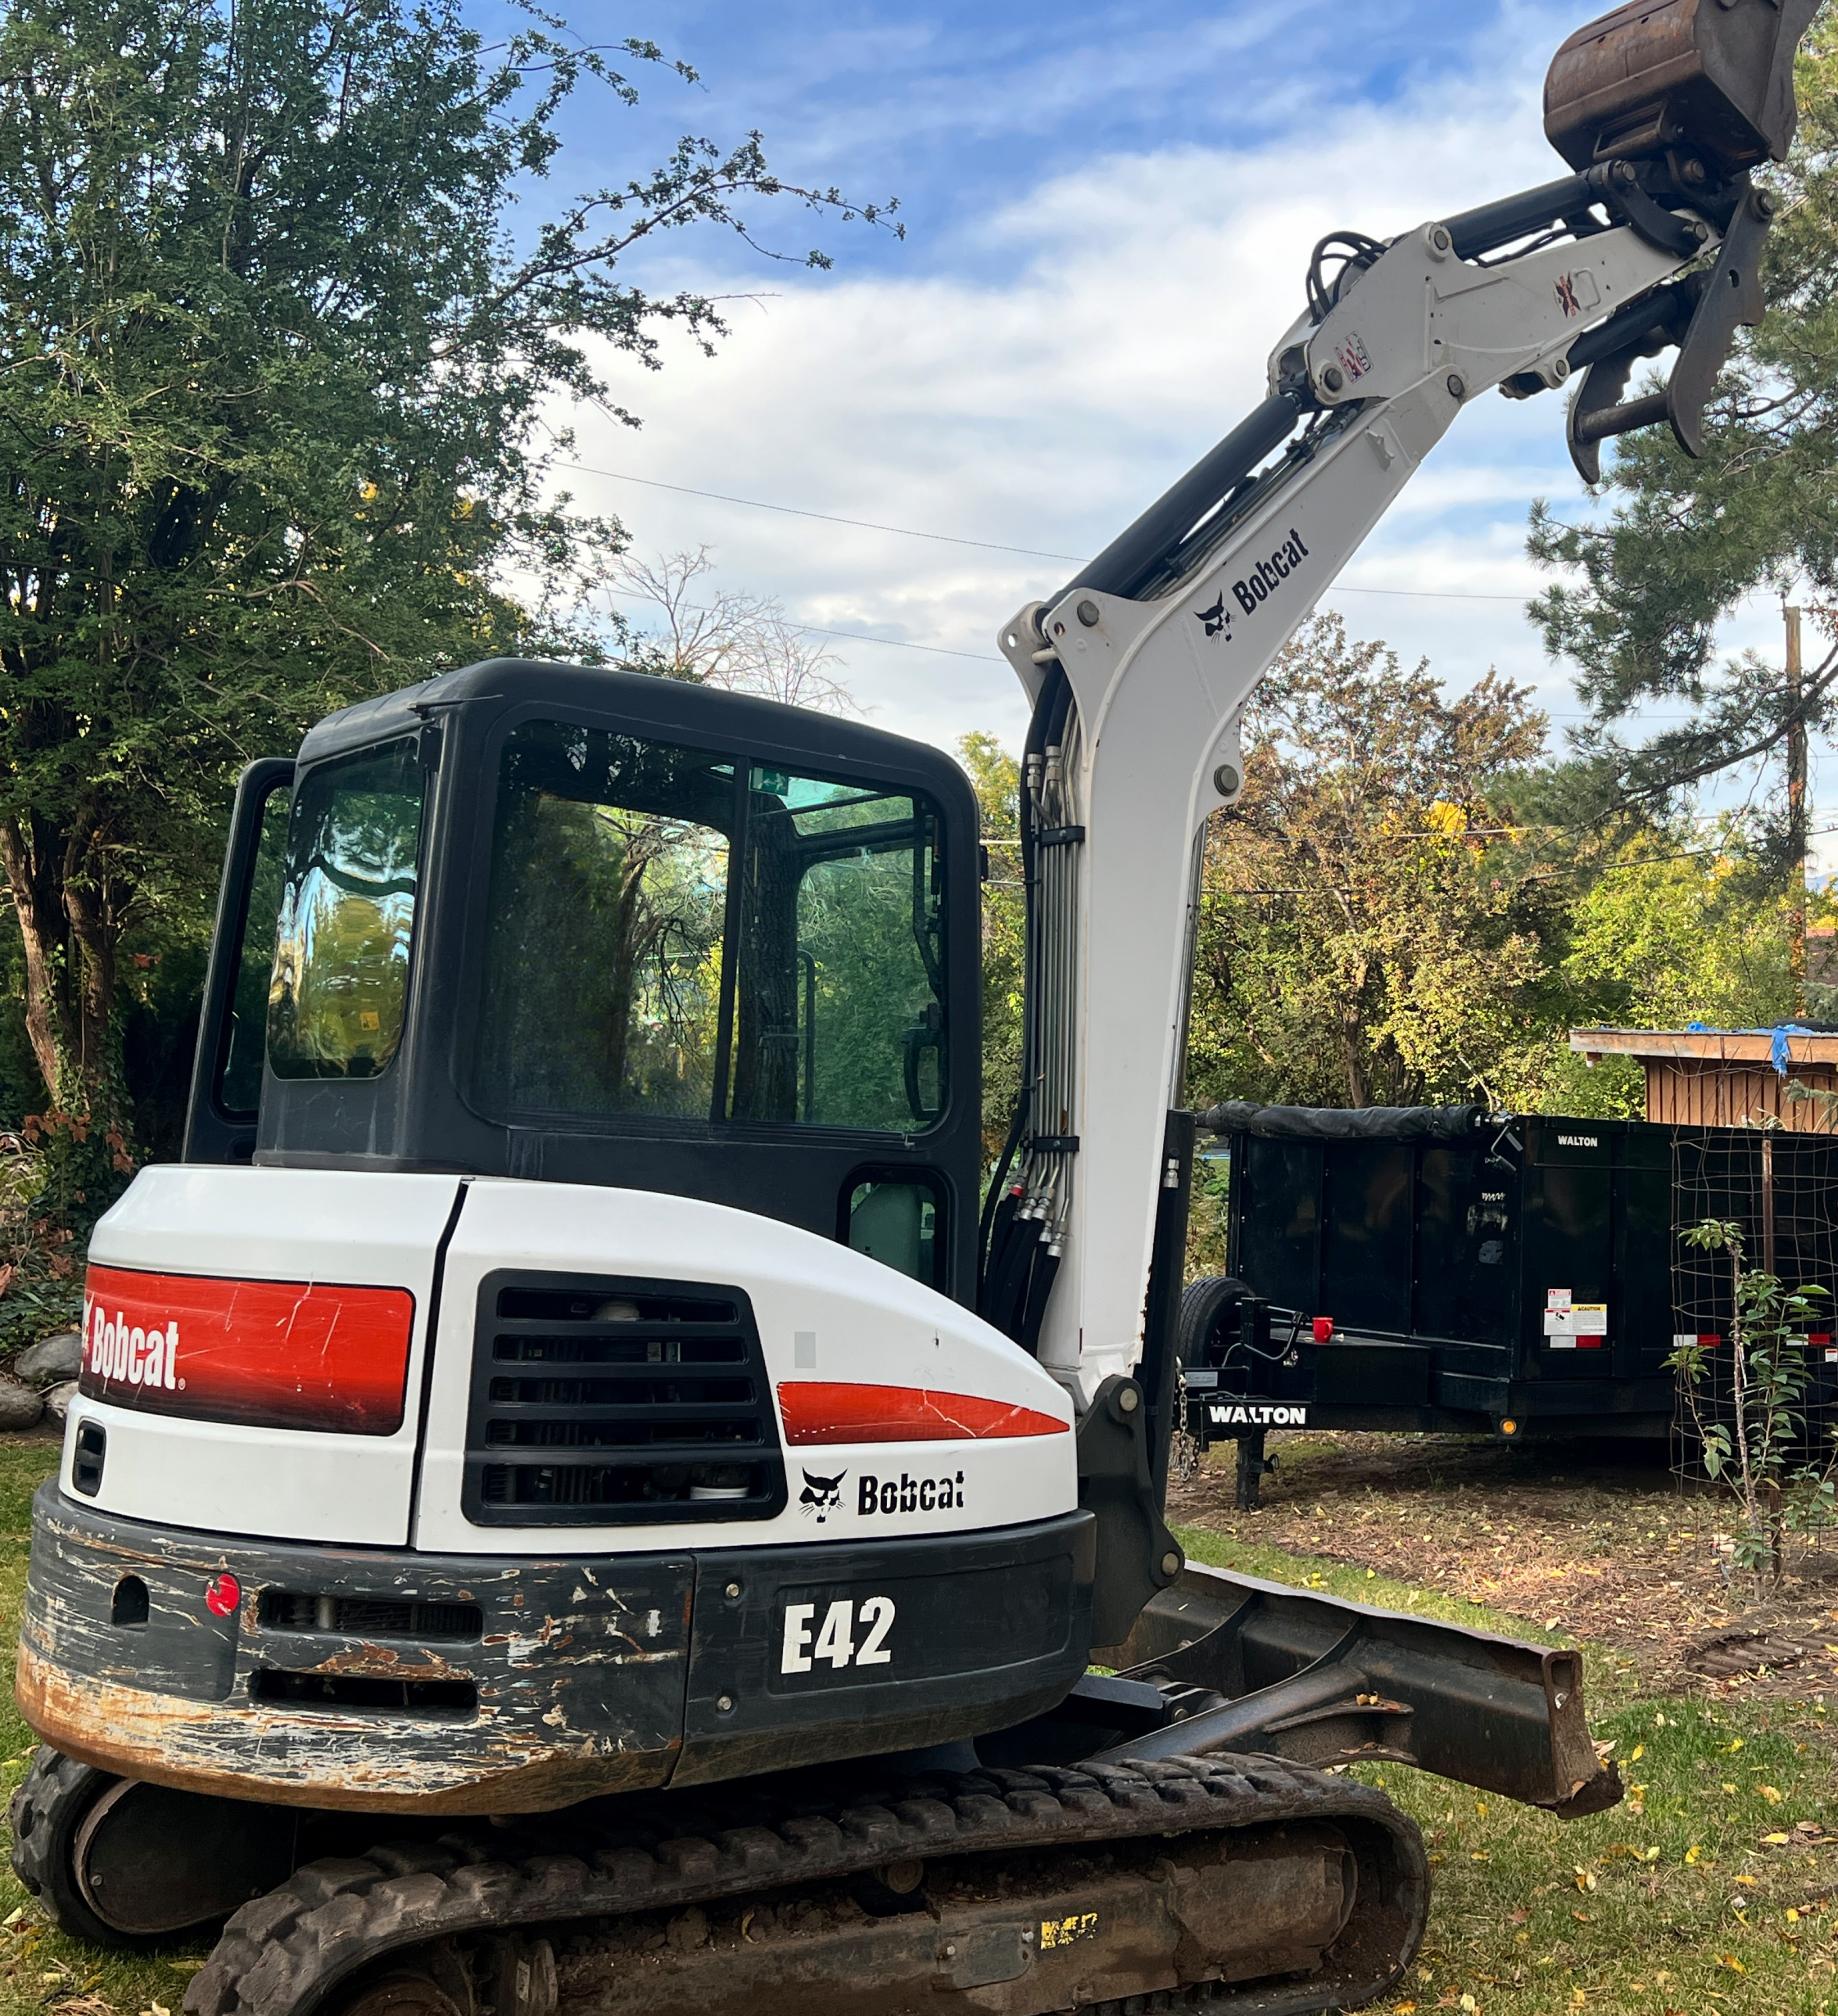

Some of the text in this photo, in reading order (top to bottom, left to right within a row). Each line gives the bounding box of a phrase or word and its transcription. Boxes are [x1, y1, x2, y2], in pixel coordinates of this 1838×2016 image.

[1232, 528, 1309, 616] Bobcat
[1557, 1135, 1598, 1147] WALTON
[91, 1306, 179, 1390] Bobcat
[1209, 1405, 1306, 1425] WALTON
[858, 1470, 964, 1516] Bobcat
[781, 1596, 896, 1674] E42
